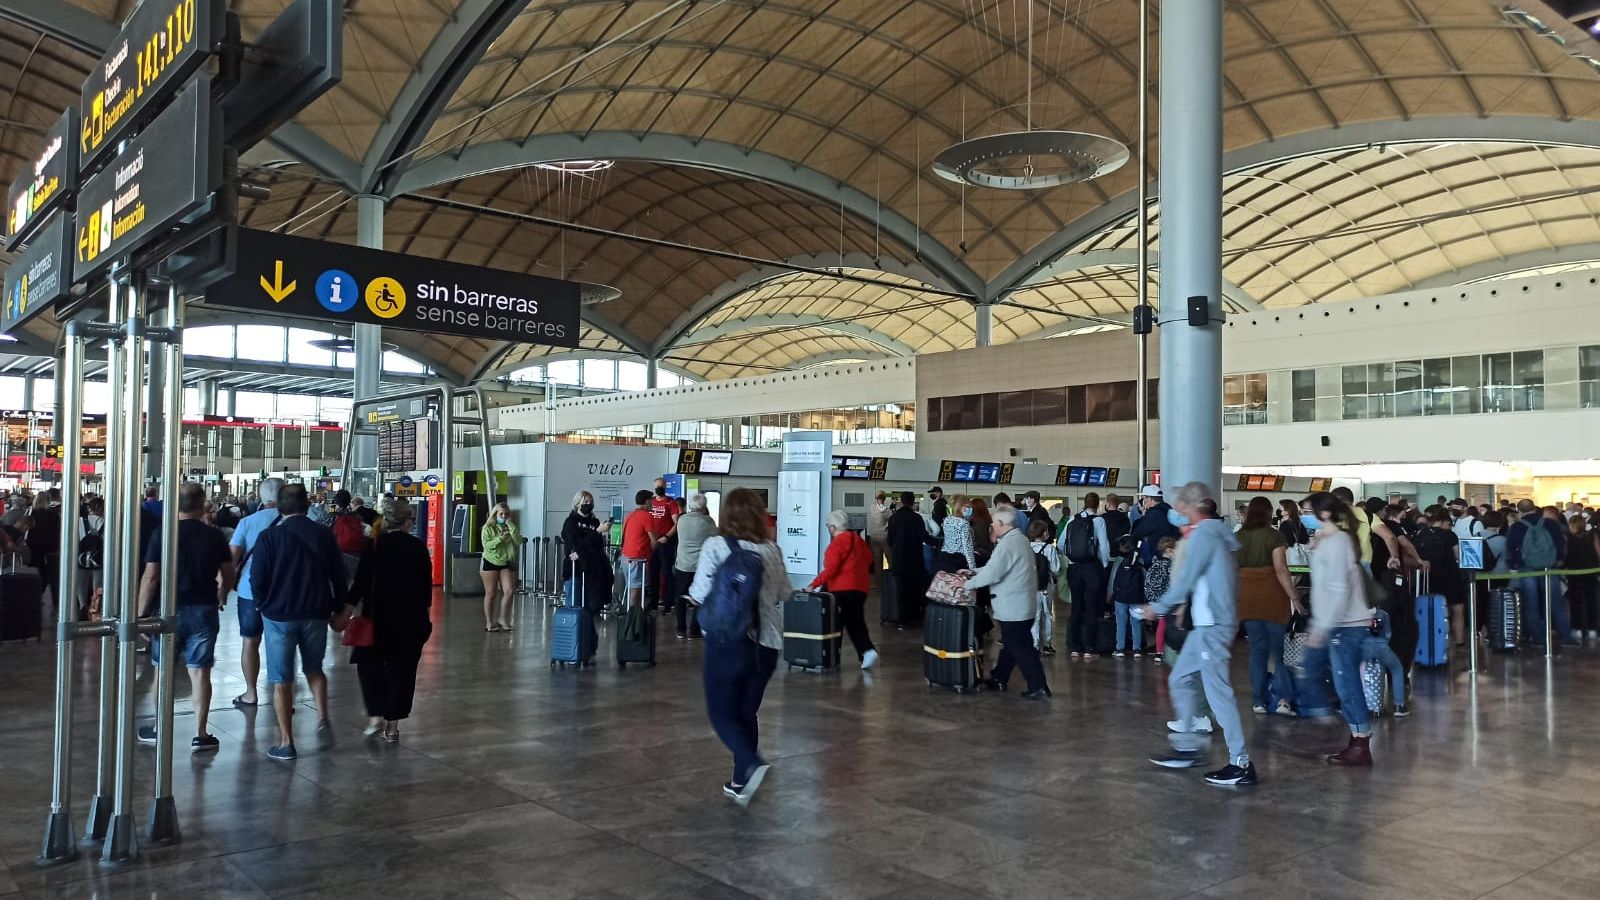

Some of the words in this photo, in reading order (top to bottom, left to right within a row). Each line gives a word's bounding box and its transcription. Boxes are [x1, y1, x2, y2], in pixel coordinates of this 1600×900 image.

[105, 38, 129, 82] Facturació
[136, 32, 158, 98] 141
[166, 0, 195, 65] 110
[104, 86, 135, 134] Facturación
[115, 147, 144, 191] Informació
[114, 183, 140, 215] Information
[113, 200, 145, 241] Información
[416, 280, 449, 302] sin
[454, 286, 539, 315] barreras
[416, 304, 480, 327] sense
[484, 310, 566, 339] barreres
[587, 458, 634, 476] vuelo
[680, 463, 696, 473] 110
[871, 469, 885, 479] 112
